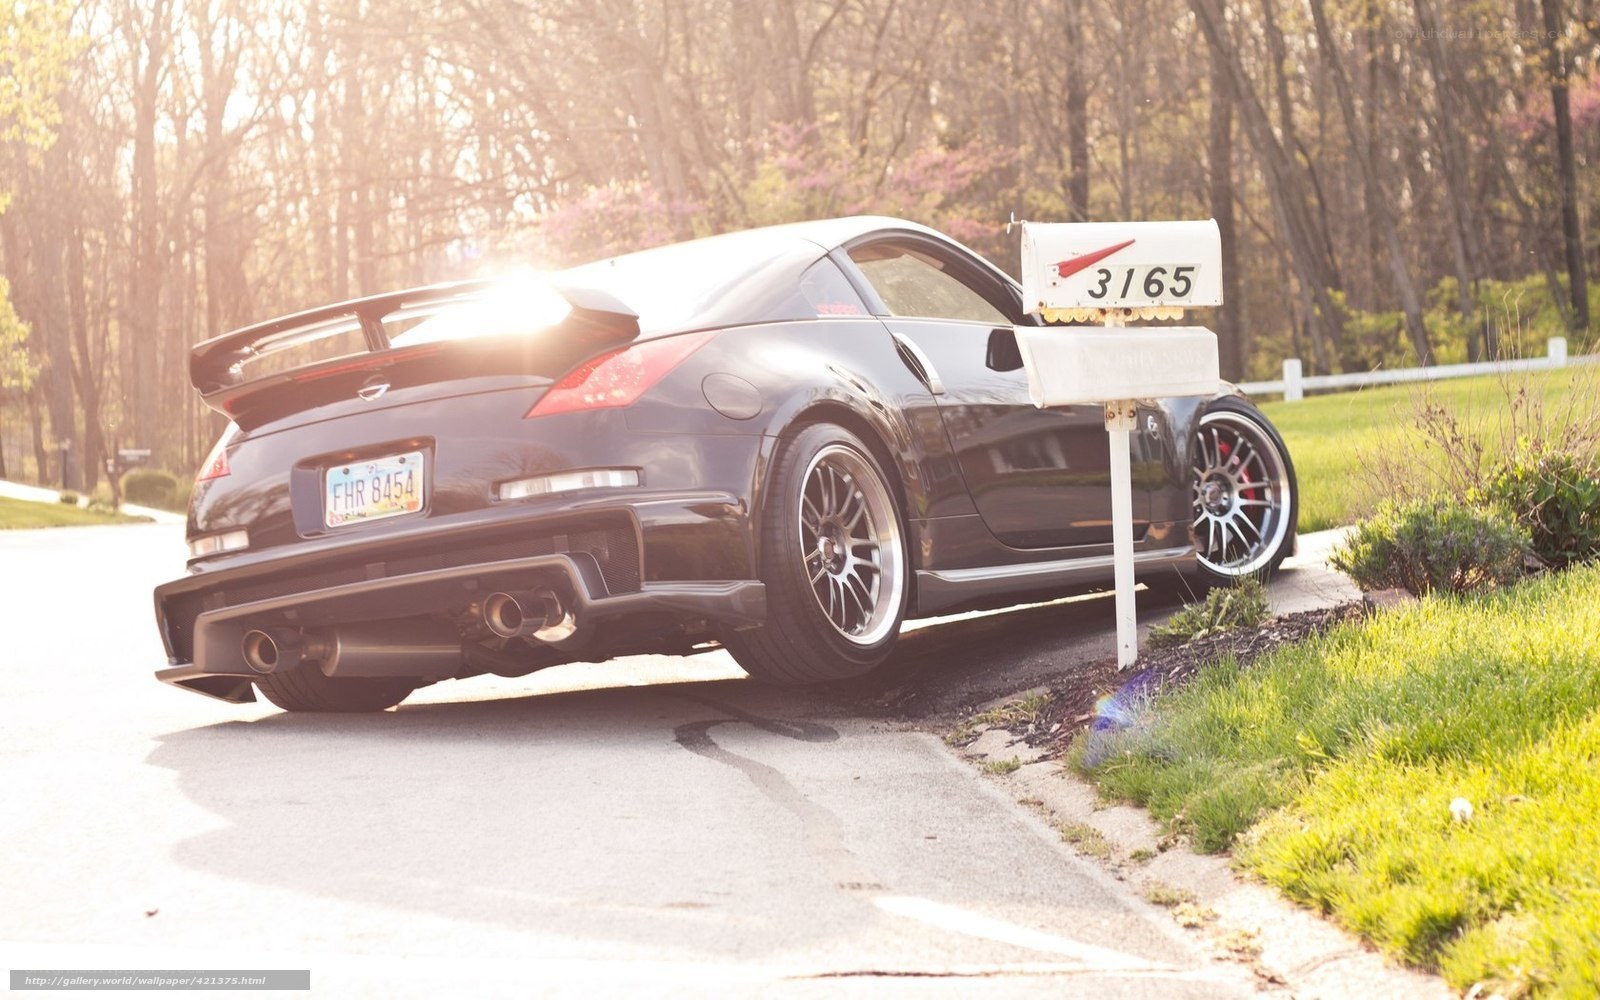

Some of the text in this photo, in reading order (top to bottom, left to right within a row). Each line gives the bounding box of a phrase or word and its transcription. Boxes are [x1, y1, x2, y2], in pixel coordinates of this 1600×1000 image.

[1088, 266, 1195, 299] 3165
[333, 469, 414, 511] FHR 8454
